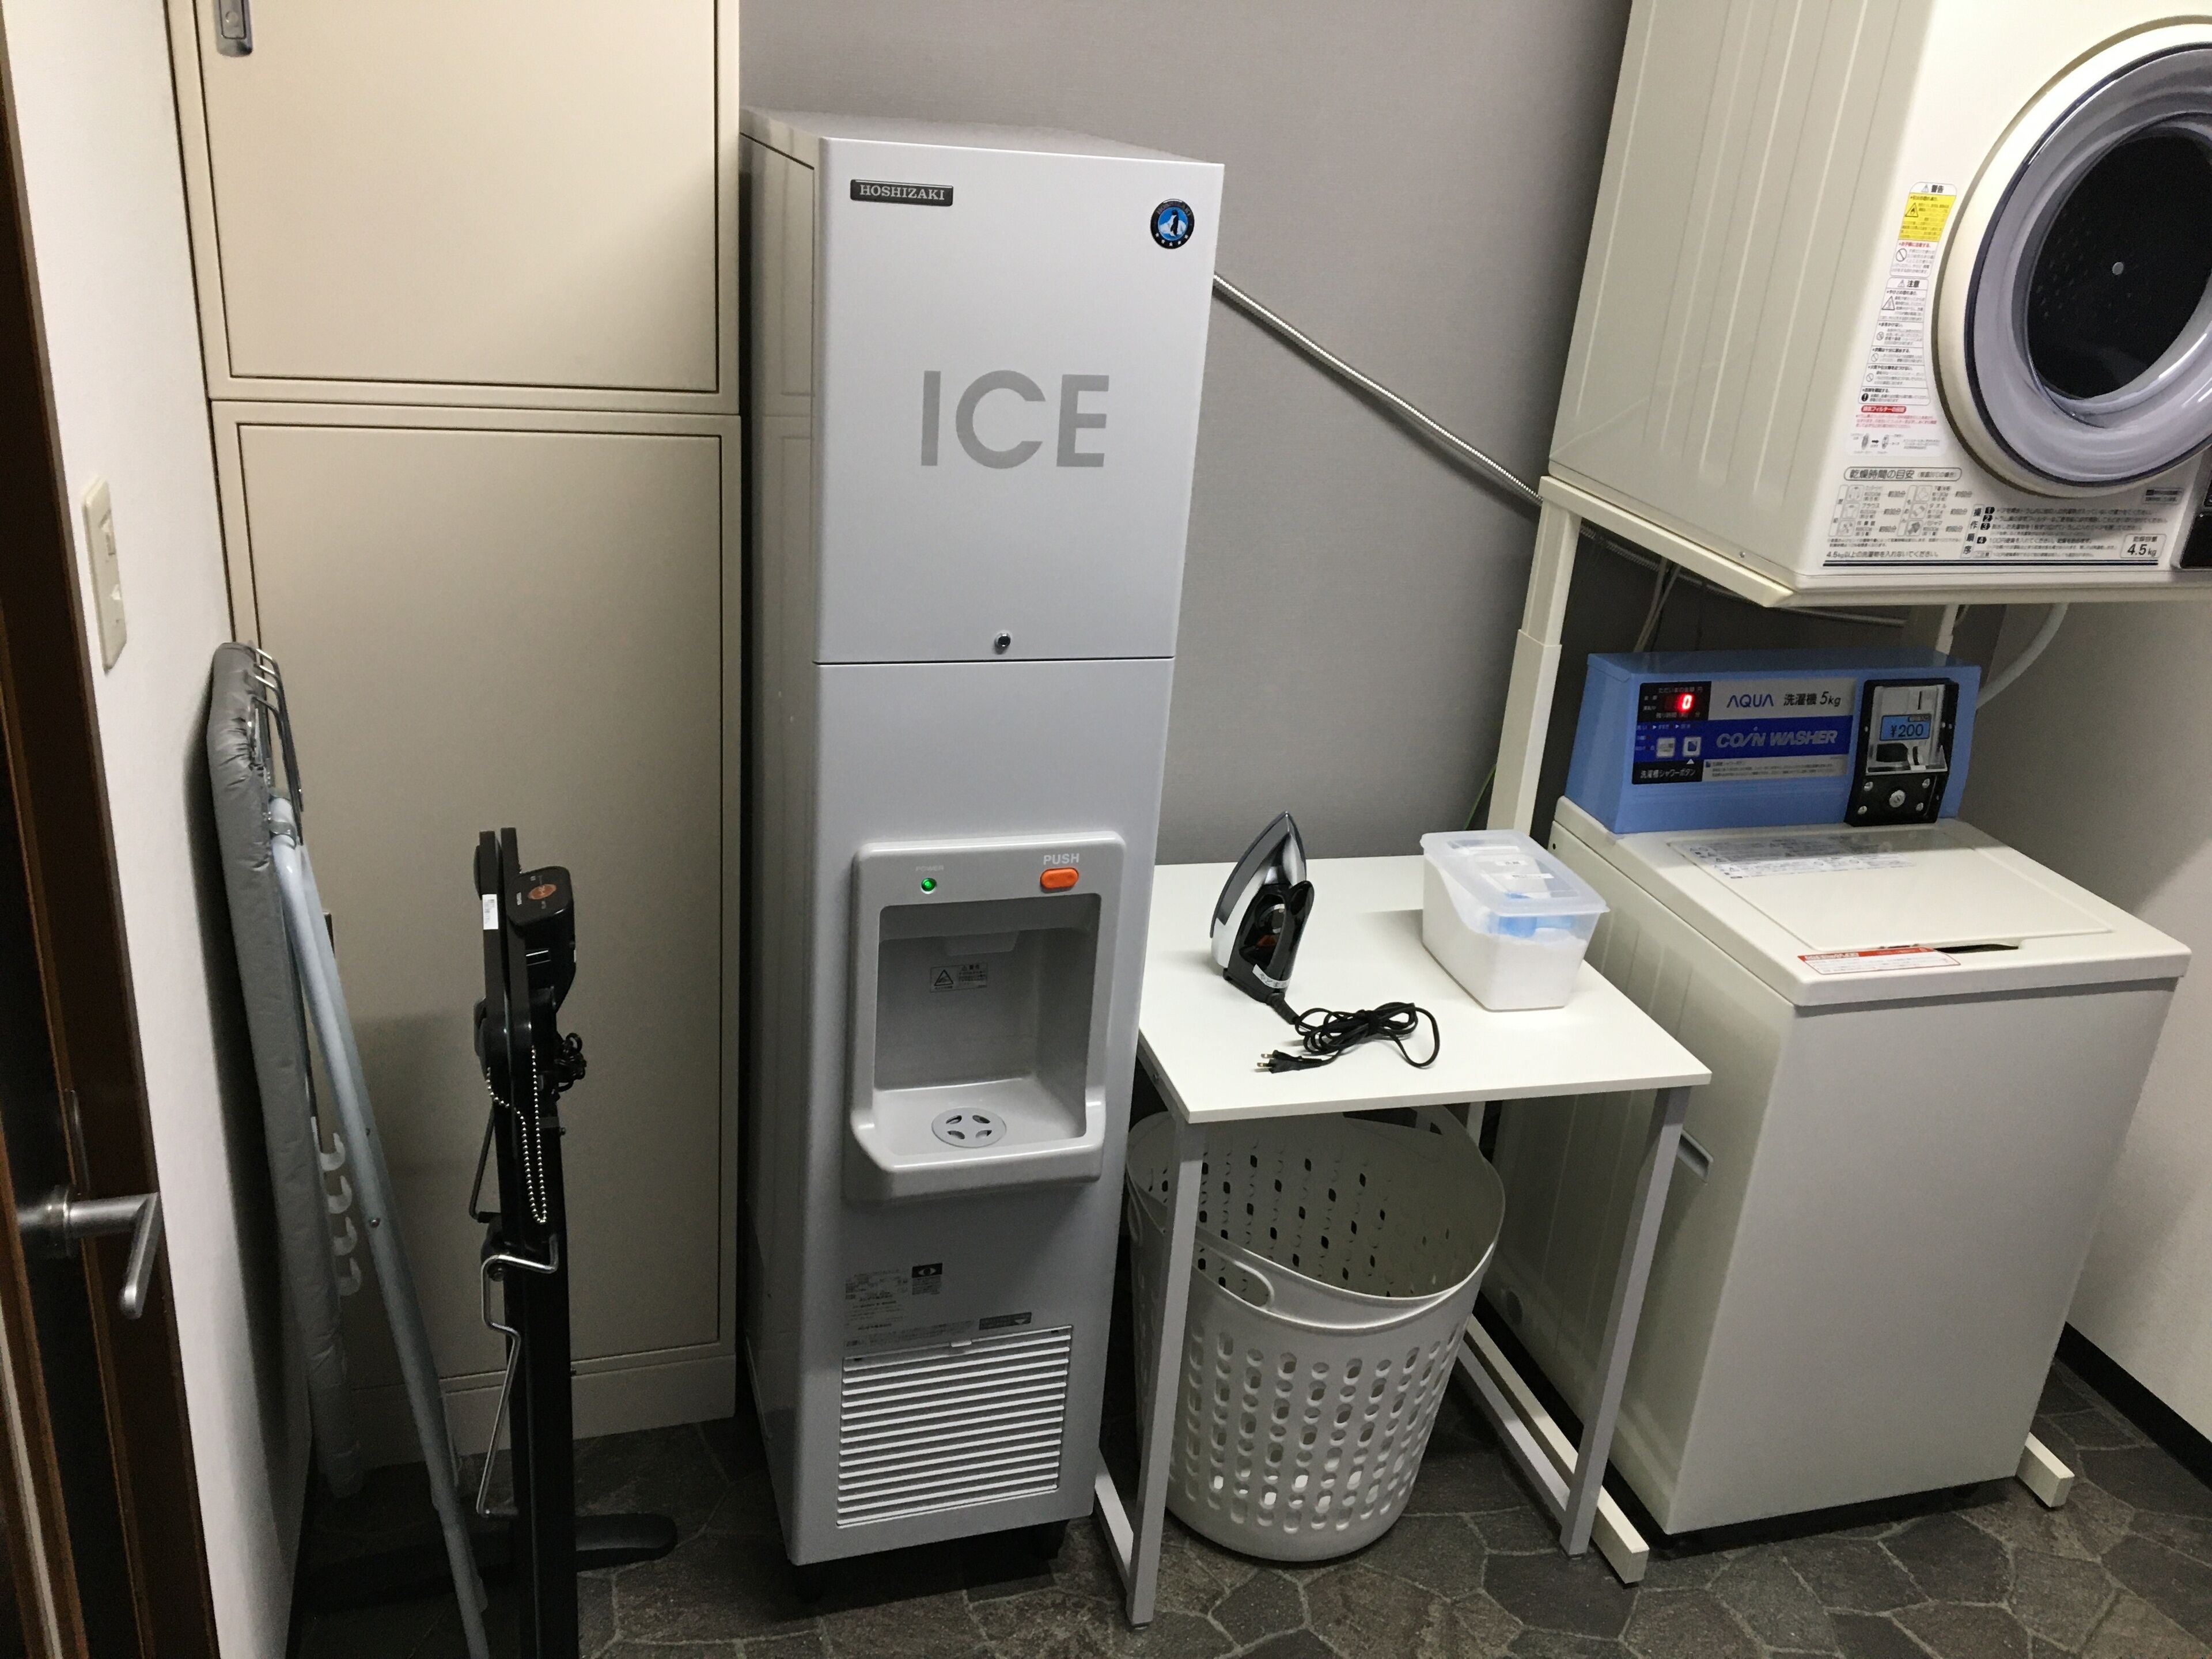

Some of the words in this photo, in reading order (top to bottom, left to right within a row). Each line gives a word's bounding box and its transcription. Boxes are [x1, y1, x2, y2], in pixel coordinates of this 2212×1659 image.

[859, 184, 945, 202] HOSHIZAKI
[1931, 184, 1944, 193] 警告
[920, 369, 1110, 469] ICE
[1850, 469, 1915, 479] 乾燥時間の目安
[1681, 694, 1693, 710] 0
[1726, 693, 1774, 709] AQUA
[1783, 692, 1817, 706] 洗濯機
[1819, 691, 1842, 707] 5kg
[1770, 729, 1838, 747] WASHER
[1891, 724, 1924, 738] ¥200
[1639, 768, 1696, 779] 洗濯機シャワーボタン
[1043, 853, 1080, 865] PUSH
